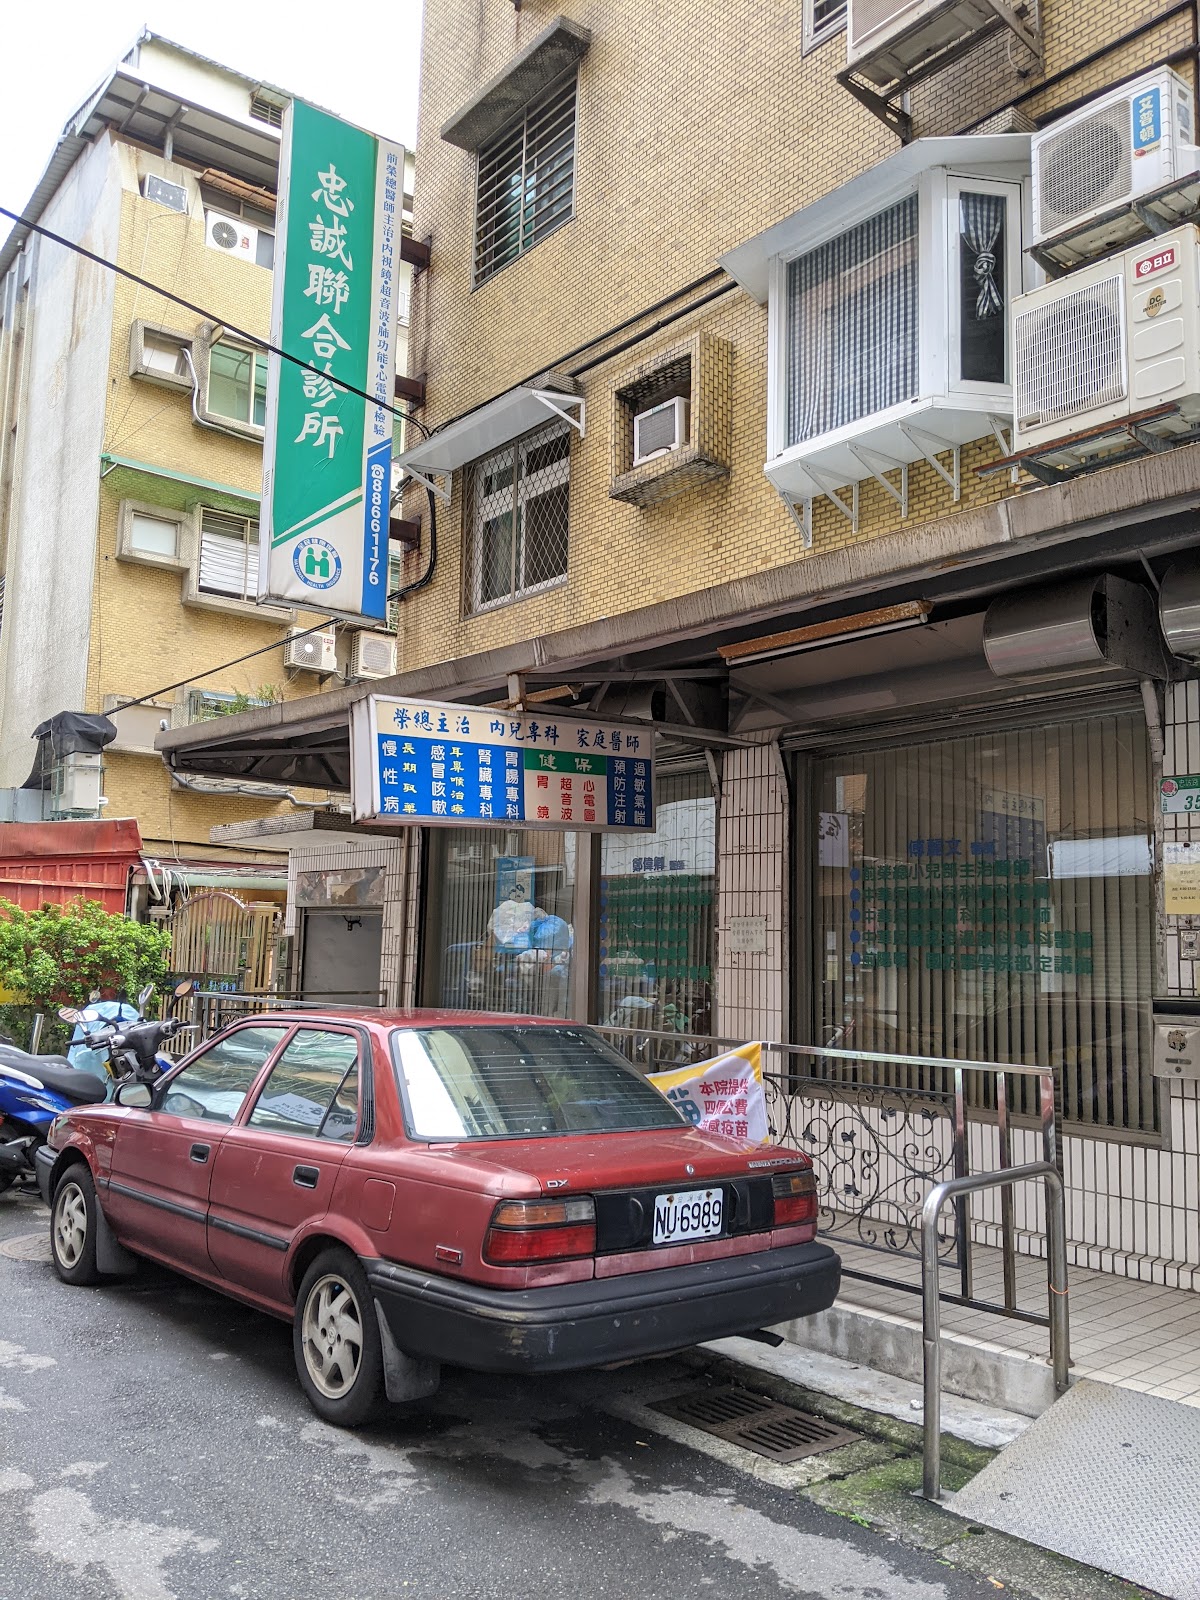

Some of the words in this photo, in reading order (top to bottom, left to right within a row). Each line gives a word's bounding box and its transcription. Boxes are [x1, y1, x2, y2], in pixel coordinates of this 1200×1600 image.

[1139, 95, 1155, 143] 艾普頓
[1153, 253, 1173, 268] 日立
[294, 163, 355, 459] 忠誠聯合診所
[1142, 299, 1167, 313] INVERTER
[1149, 294, 1162, 306] DC
[369, 478, 382, 586] 88661176
[393, 706, 471, 735] 榮總主治
[490, 719, 560, 746] 內兒專科
[576, 727, 640, 753] 家庭醫師
[382, 740, 399, 813] 慢性病
[430, 744, 447, 815] 感冒咳嗽
[450, 746, 465, 815] 耳鼻喉治療
[478, 748, 493, 818] 腎臟專科
[505, 750, 520, 819] 胃腸專科
[539, 753, 592, 773] 健保
[537, 775, 549, 819] 胃鏡
[560, 777, 572, 821] 超音波
[583, 779, 595, 821] 心電圖
[613, 759, 627, 824] 預防注射
[633, 761, 646, 826] 過敏氣喘
[699, 1078, 749, 1096] 本院提供
[547, 1179, 569, 1188] DX
